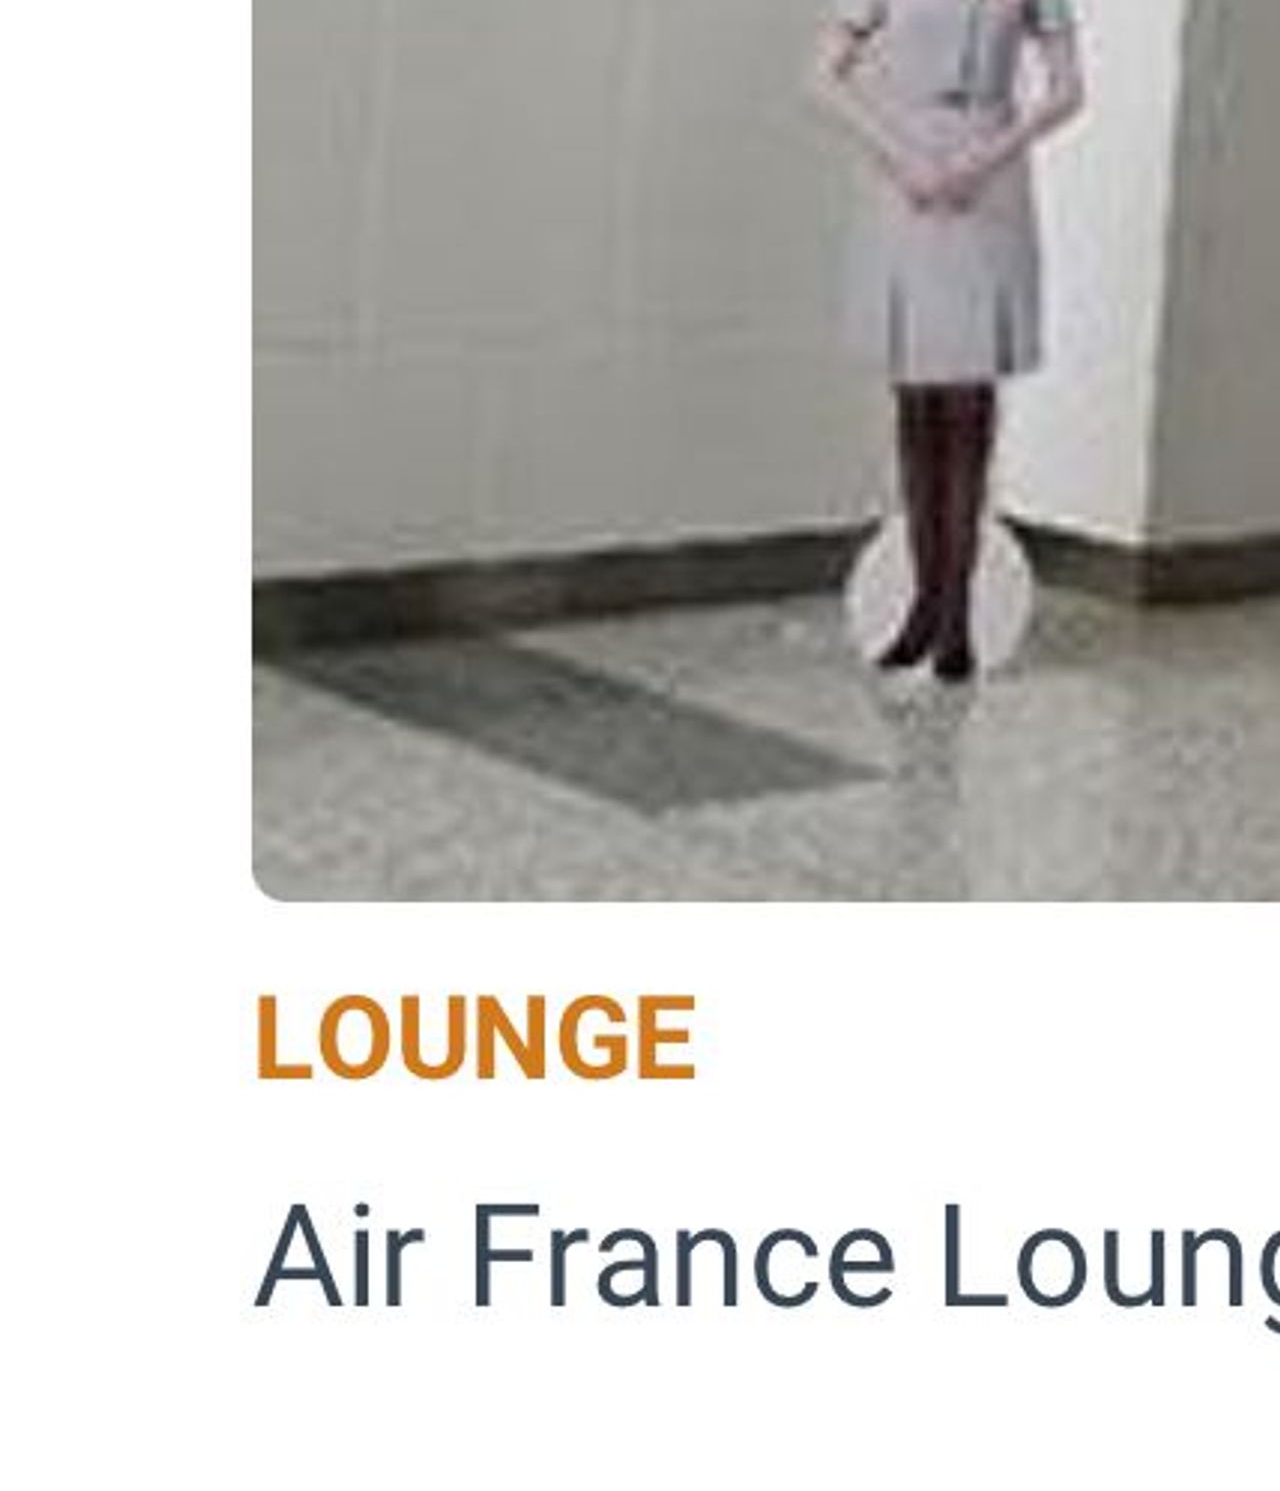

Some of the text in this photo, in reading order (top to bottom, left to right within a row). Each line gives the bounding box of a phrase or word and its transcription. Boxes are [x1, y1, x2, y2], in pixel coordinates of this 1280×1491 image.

[257, 994, 696, 1081] LOUNGE
[254, 1202, 425, 1307] Air
[475, 1203, 895, 1309] France
